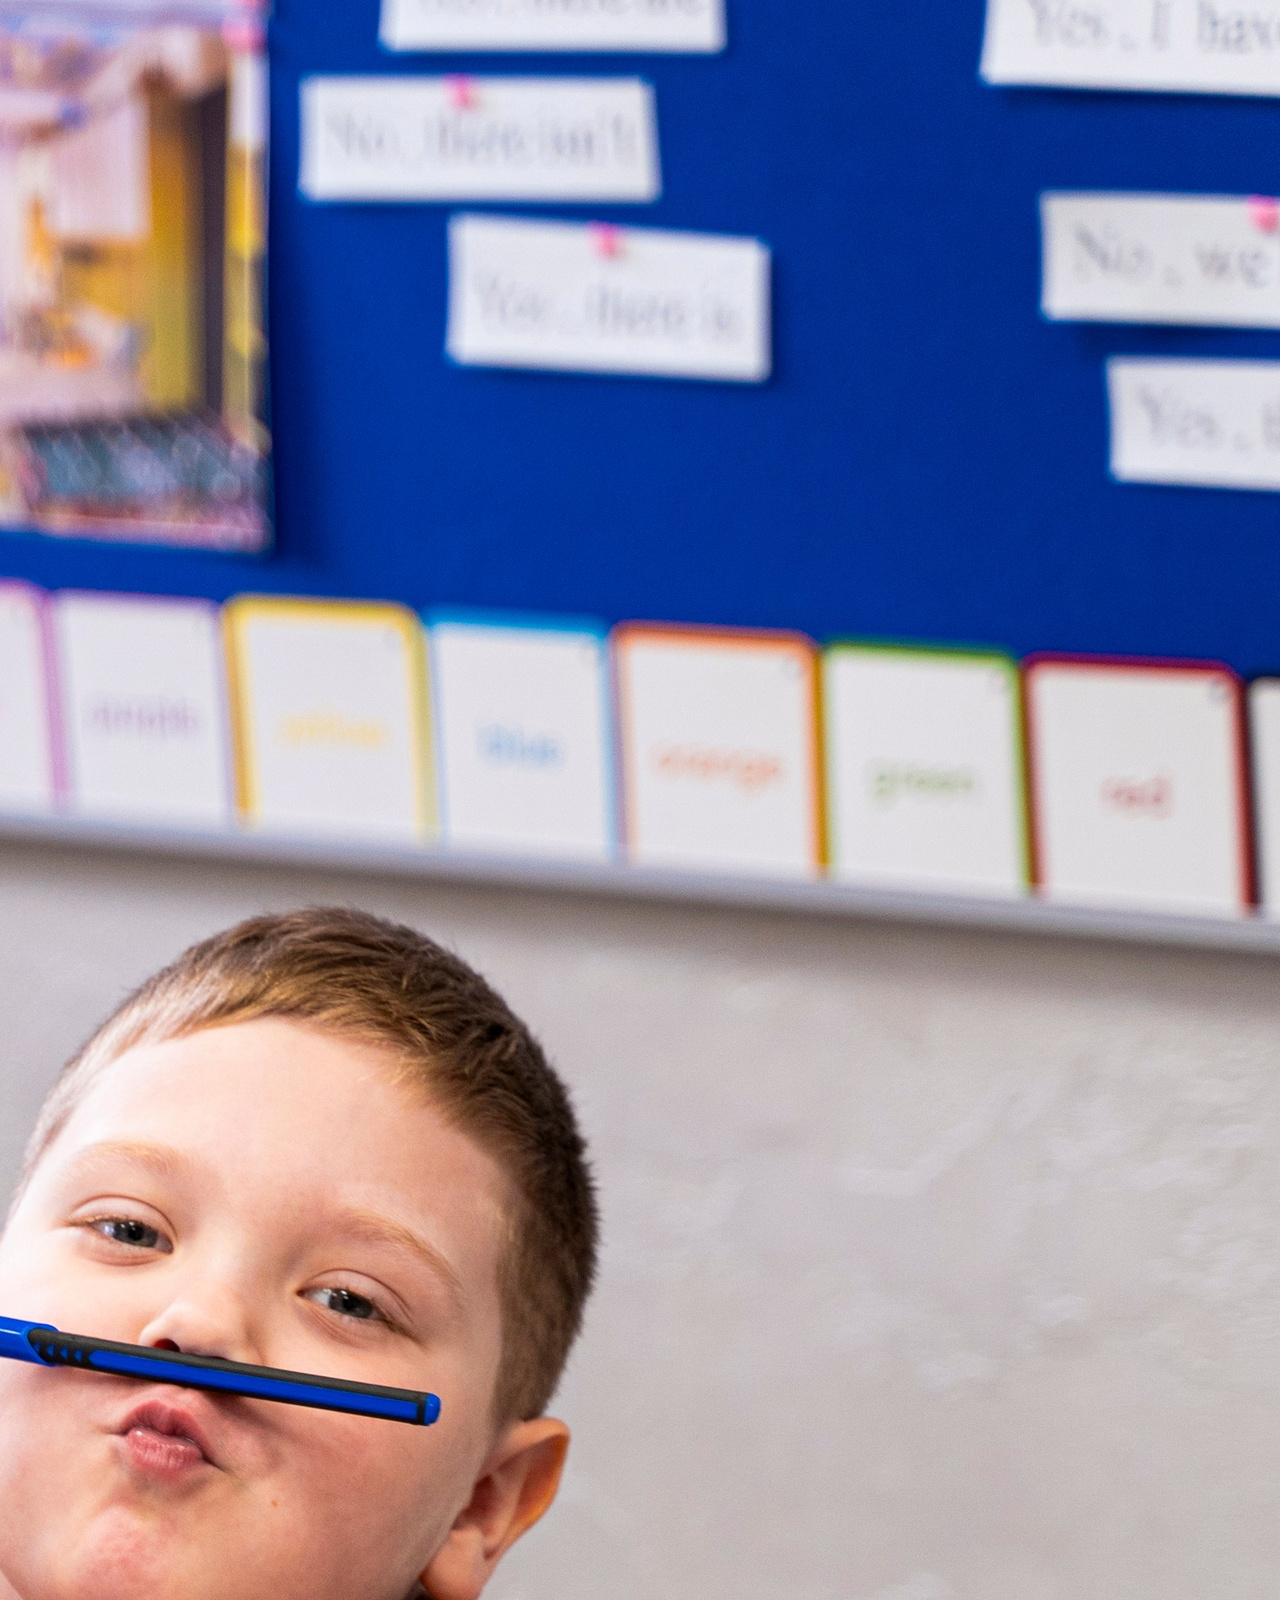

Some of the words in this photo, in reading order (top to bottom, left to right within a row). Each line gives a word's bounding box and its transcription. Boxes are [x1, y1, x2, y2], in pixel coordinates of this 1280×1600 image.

[1196, 0, 1280, 54] hav
[1194, 242, 1268, 289] we
[479, 723, 562, 769] blue
[654, 742, 783, 797] orange
[869, 760, 978, 810] green
[1102, 768, 1169, 818] red
